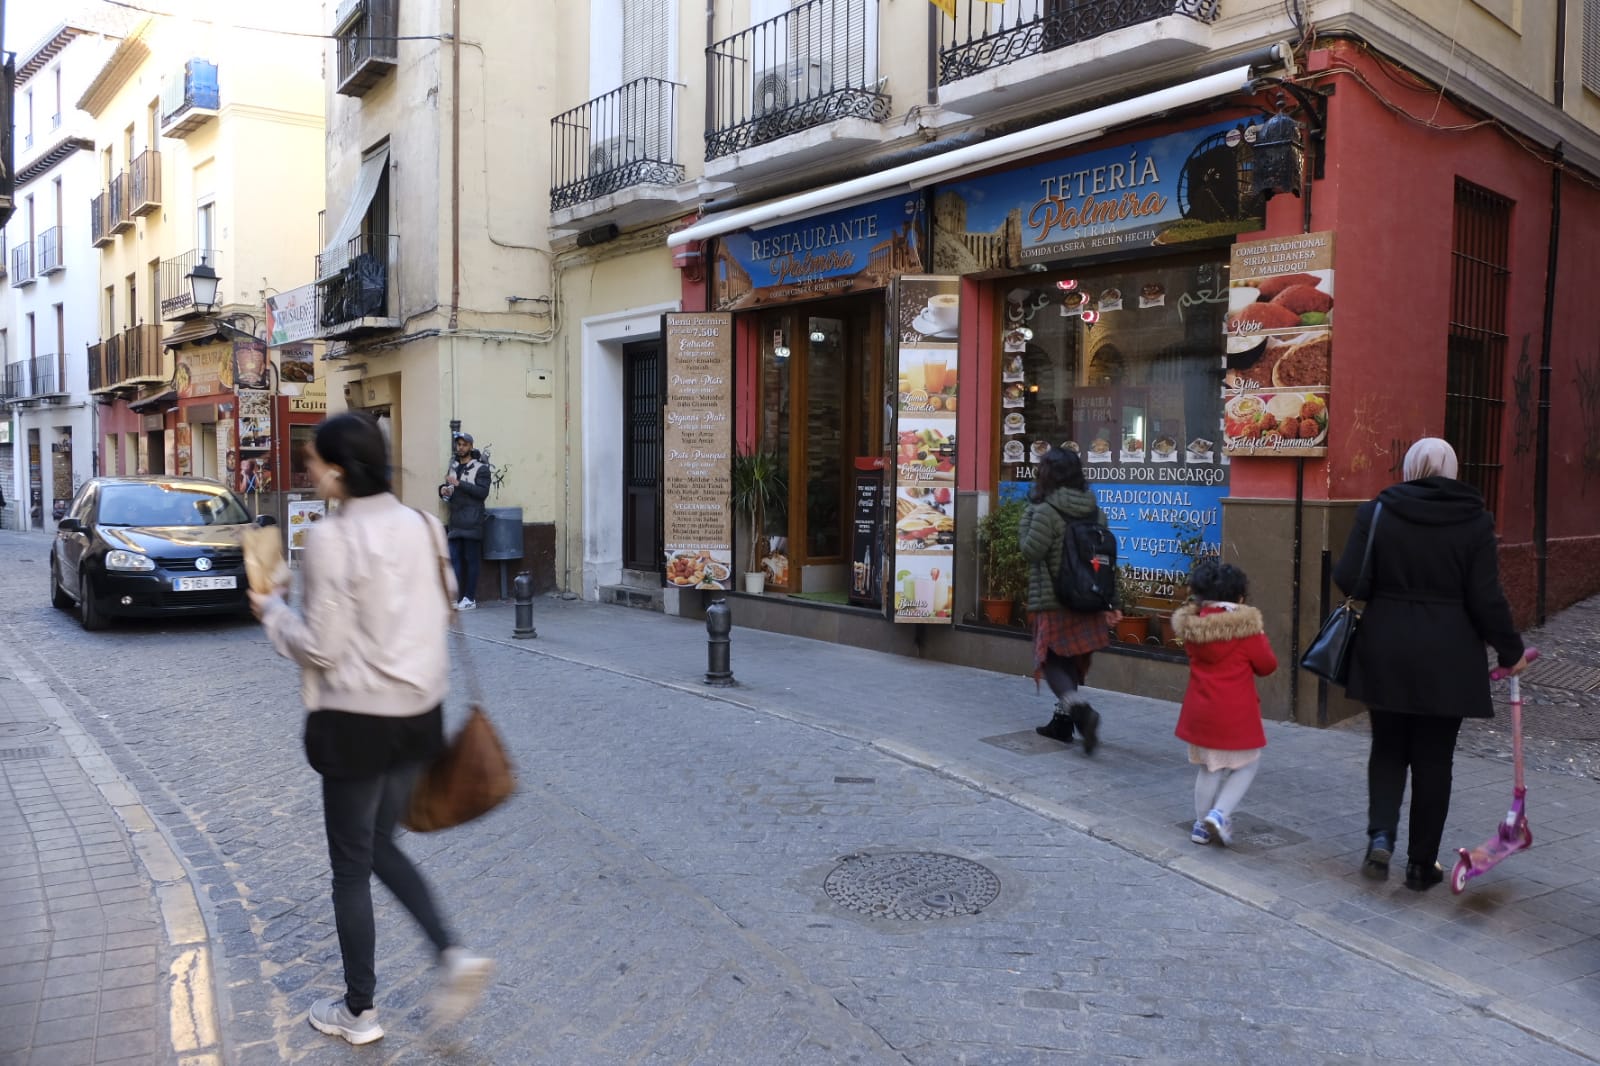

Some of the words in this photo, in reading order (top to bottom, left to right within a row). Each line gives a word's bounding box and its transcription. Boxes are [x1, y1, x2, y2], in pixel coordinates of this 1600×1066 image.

[1040, 151, 1160, 203] TETERÍA
[1028, 191, 1168, 242] Palmira
[751, 215, 878, 261] RESTAURANTE
[1074, 222, 1118, 239] SIRIA
[1020, 247, 1053, 258] COMIDA
[1053, 241, 1086, 254] CASERA
[1125, 229, 1156, 243] HECHA
[1236, 244, 1268, 257] COMIDA
[1270, 238, 1326, 252] TRADICIONAL
[1272, 250, 1316, 263] LIBANESA
[769, 249, 856, 287] Palmira
[1250, 267, 1256, 276] Y
[1231, 319, 1263, 336] Kibbe
[1269, 433, 1315, 453] Hummus
[1129, 467, 1156, 481] POR
[1158, 467, 1225, 486] ENCARGO
[1098, 489, 1192, 506] TRADICIONAL
[1138, 506, 1218, 528] MARROQUÍ
[1119, 536, 1127, 550] Y
